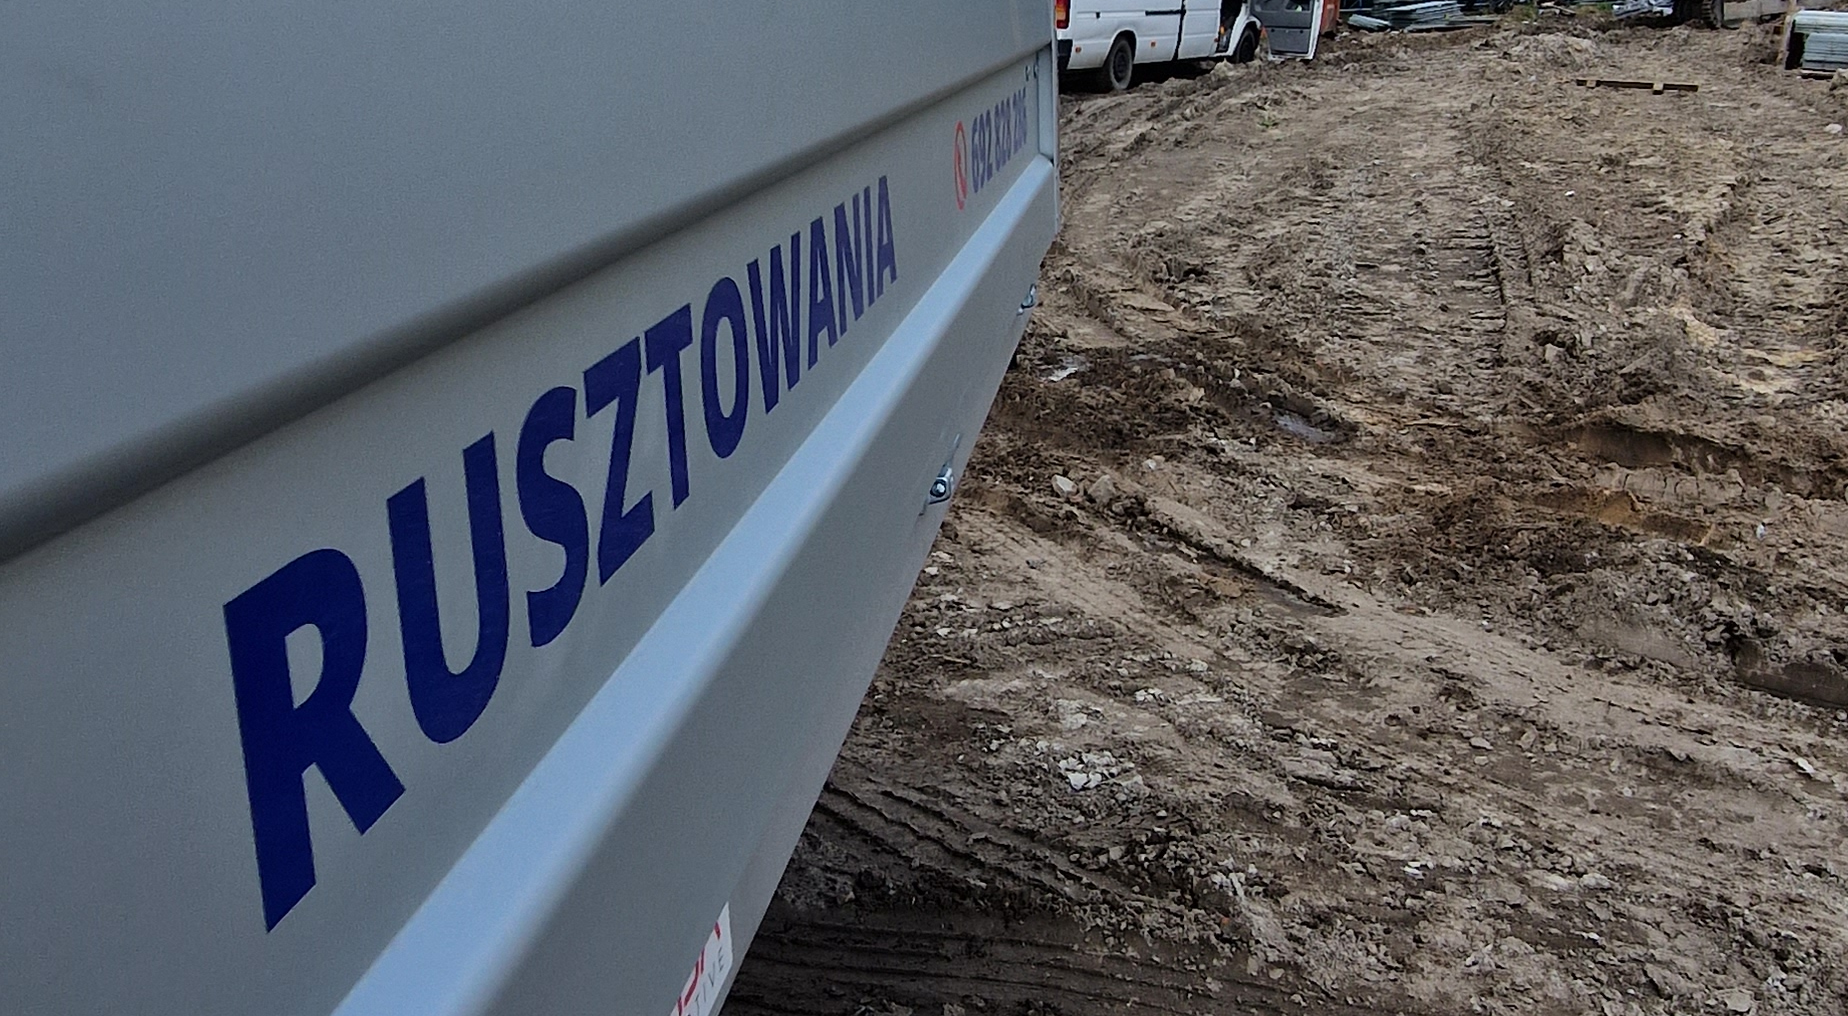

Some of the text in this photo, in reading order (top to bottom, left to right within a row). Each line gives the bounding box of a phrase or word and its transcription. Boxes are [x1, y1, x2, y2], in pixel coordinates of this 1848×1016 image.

[971, 109, 992, 194] 692
[223, 175, 897, 933] RUSZTOWANIA
[687, 946, 725, 1016] TIVE
